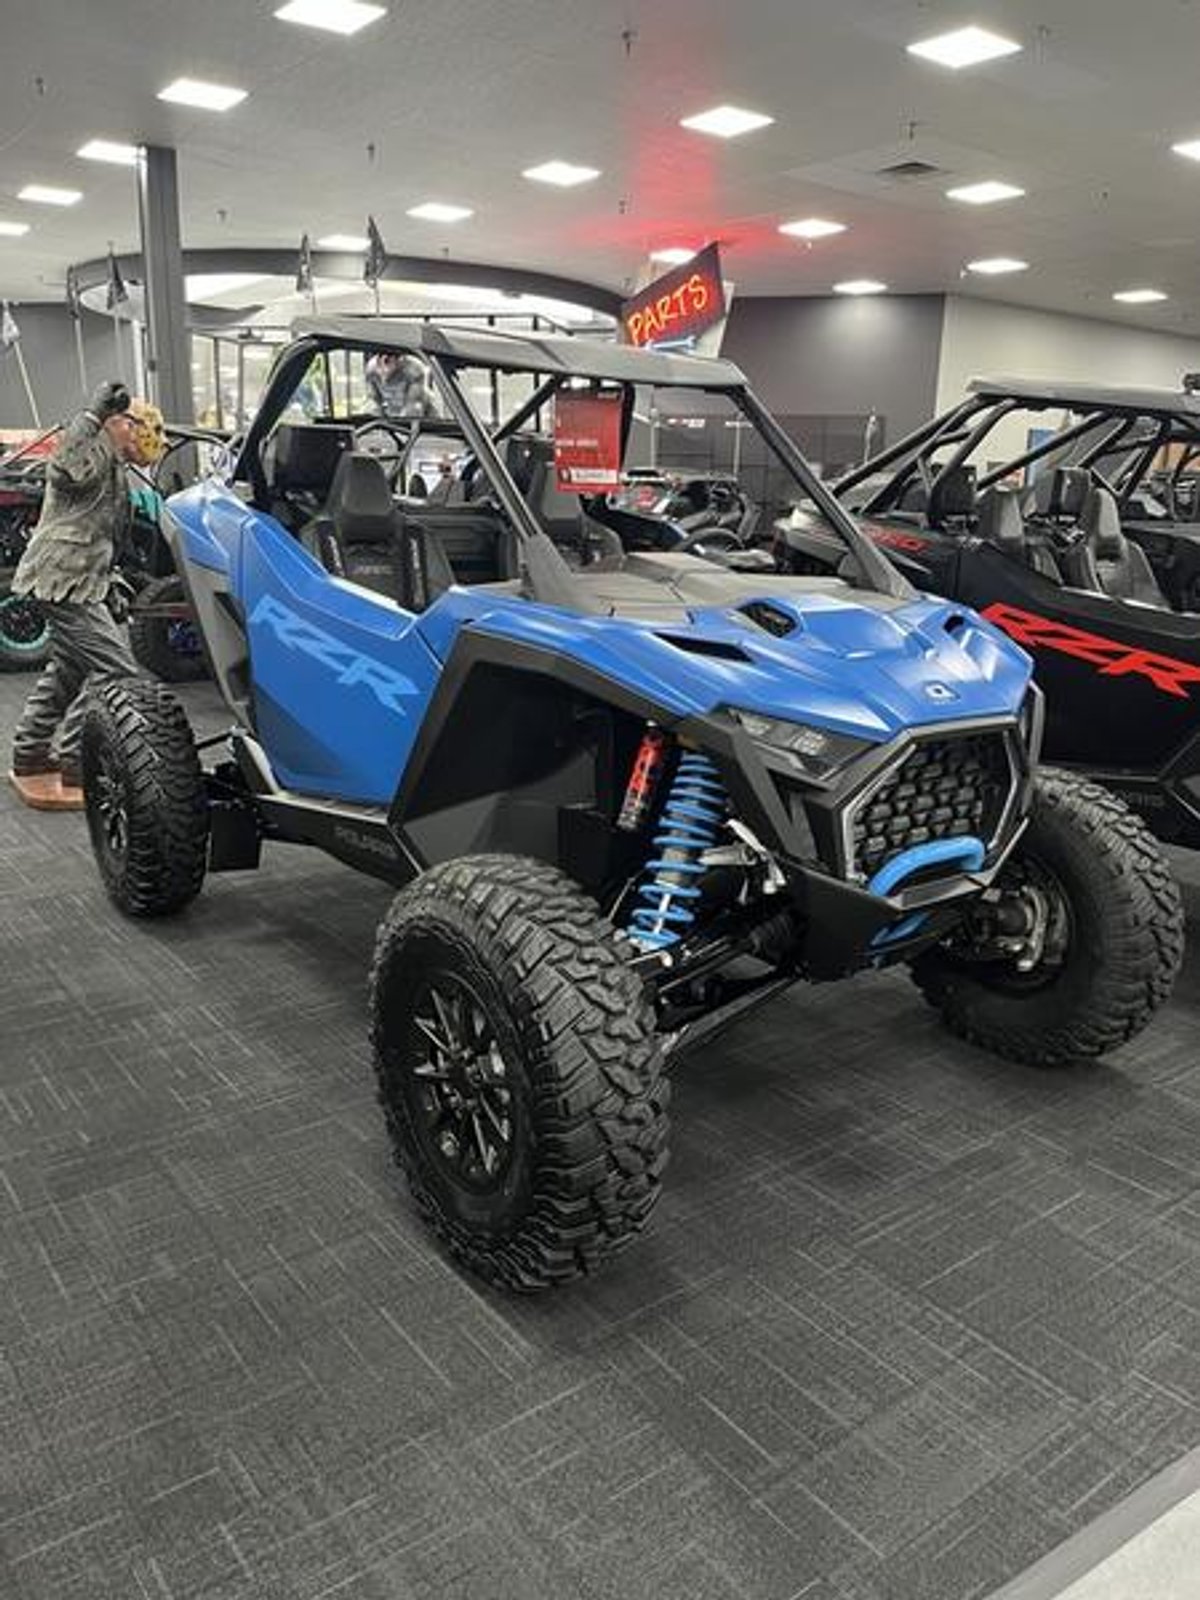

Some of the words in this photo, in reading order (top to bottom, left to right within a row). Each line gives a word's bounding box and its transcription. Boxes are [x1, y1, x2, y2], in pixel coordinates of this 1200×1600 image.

[627, 274, 708, 346] PARTS
[248, 594, 420, 717] RZR
[980, 602, 1200, 698] RZR
